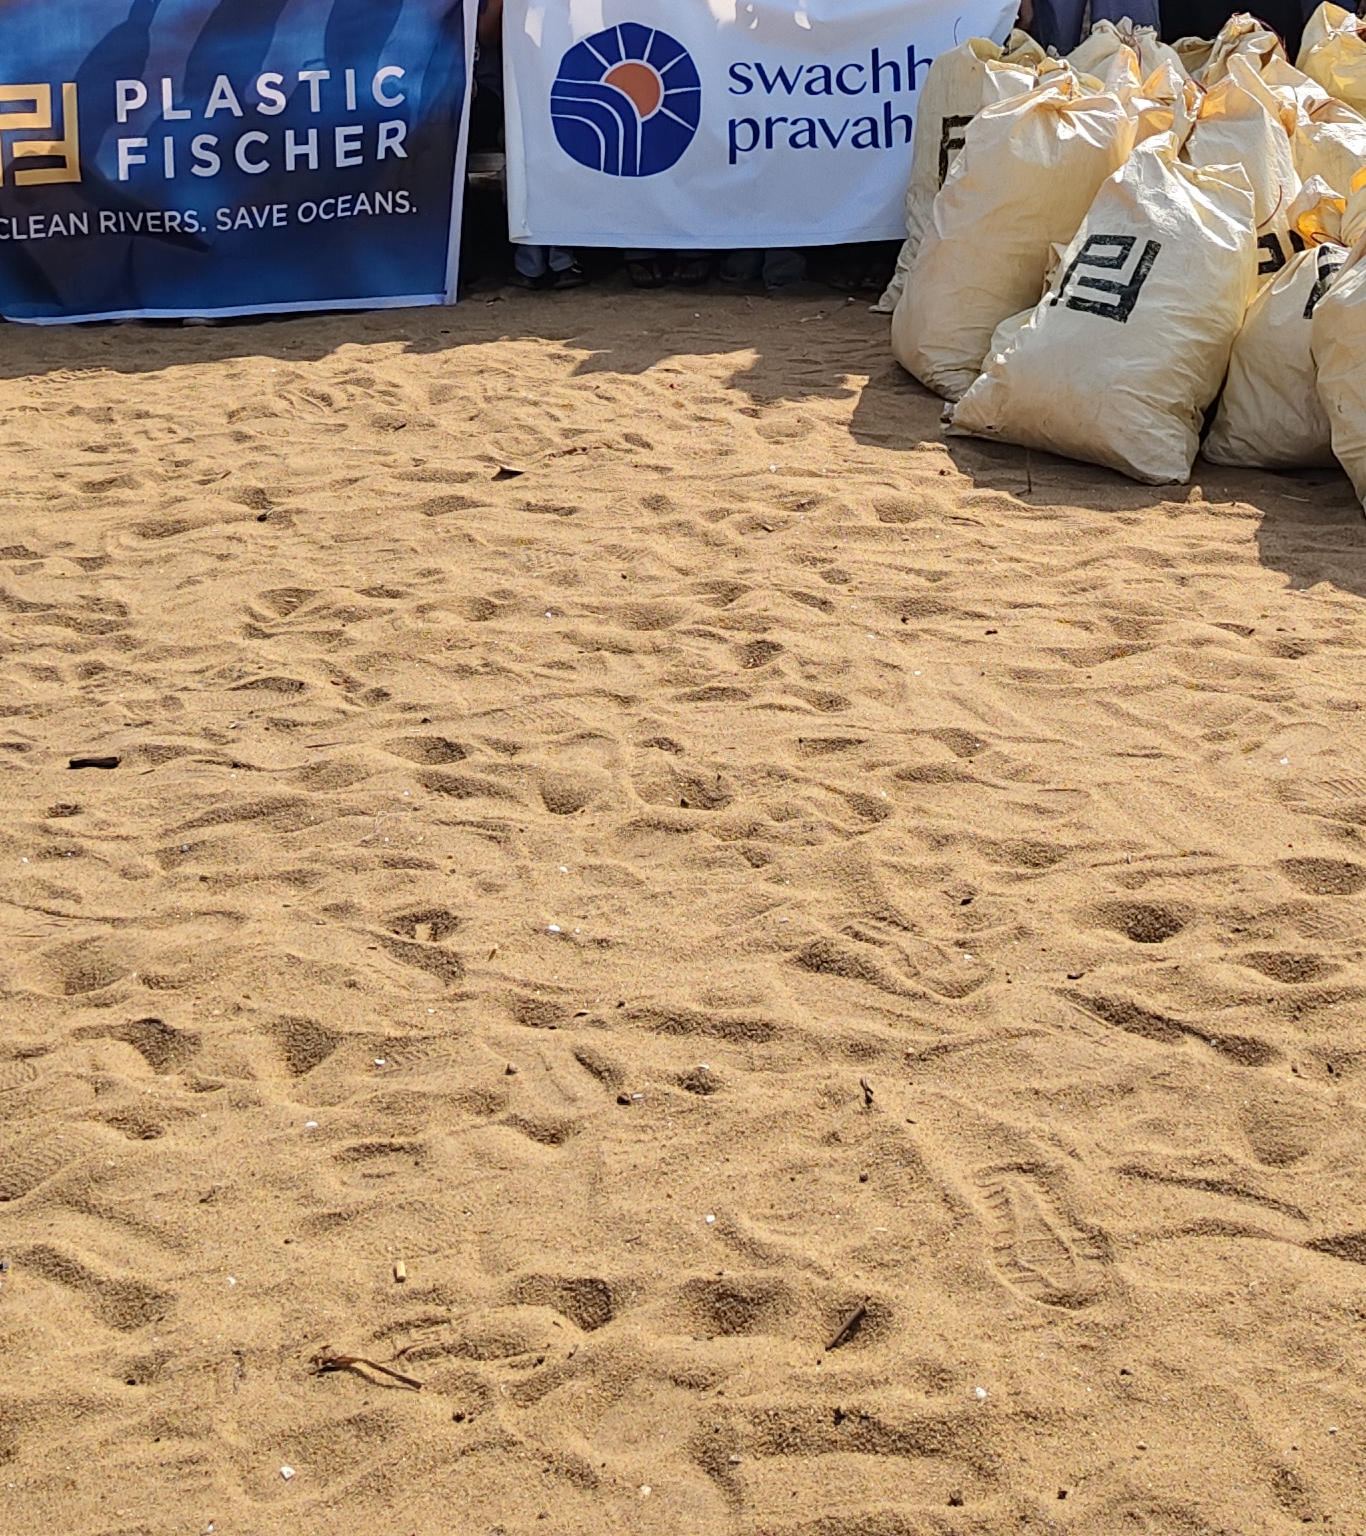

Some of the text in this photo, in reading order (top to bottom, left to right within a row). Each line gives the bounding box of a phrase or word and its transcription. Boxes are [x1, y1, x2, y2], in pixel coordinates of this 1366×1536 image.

[115, 66, 406, 123] PLASTIC
[728, 44, 933, 95] swachh
[117, 119, 408, 181] FISCHER
[728, 100, 913, 165] pravah
[100, 209, 206, 235] RIVERS.
[216, 204, 288, 231] SAVE
[297, 190, 417, 224] OCEANS.
